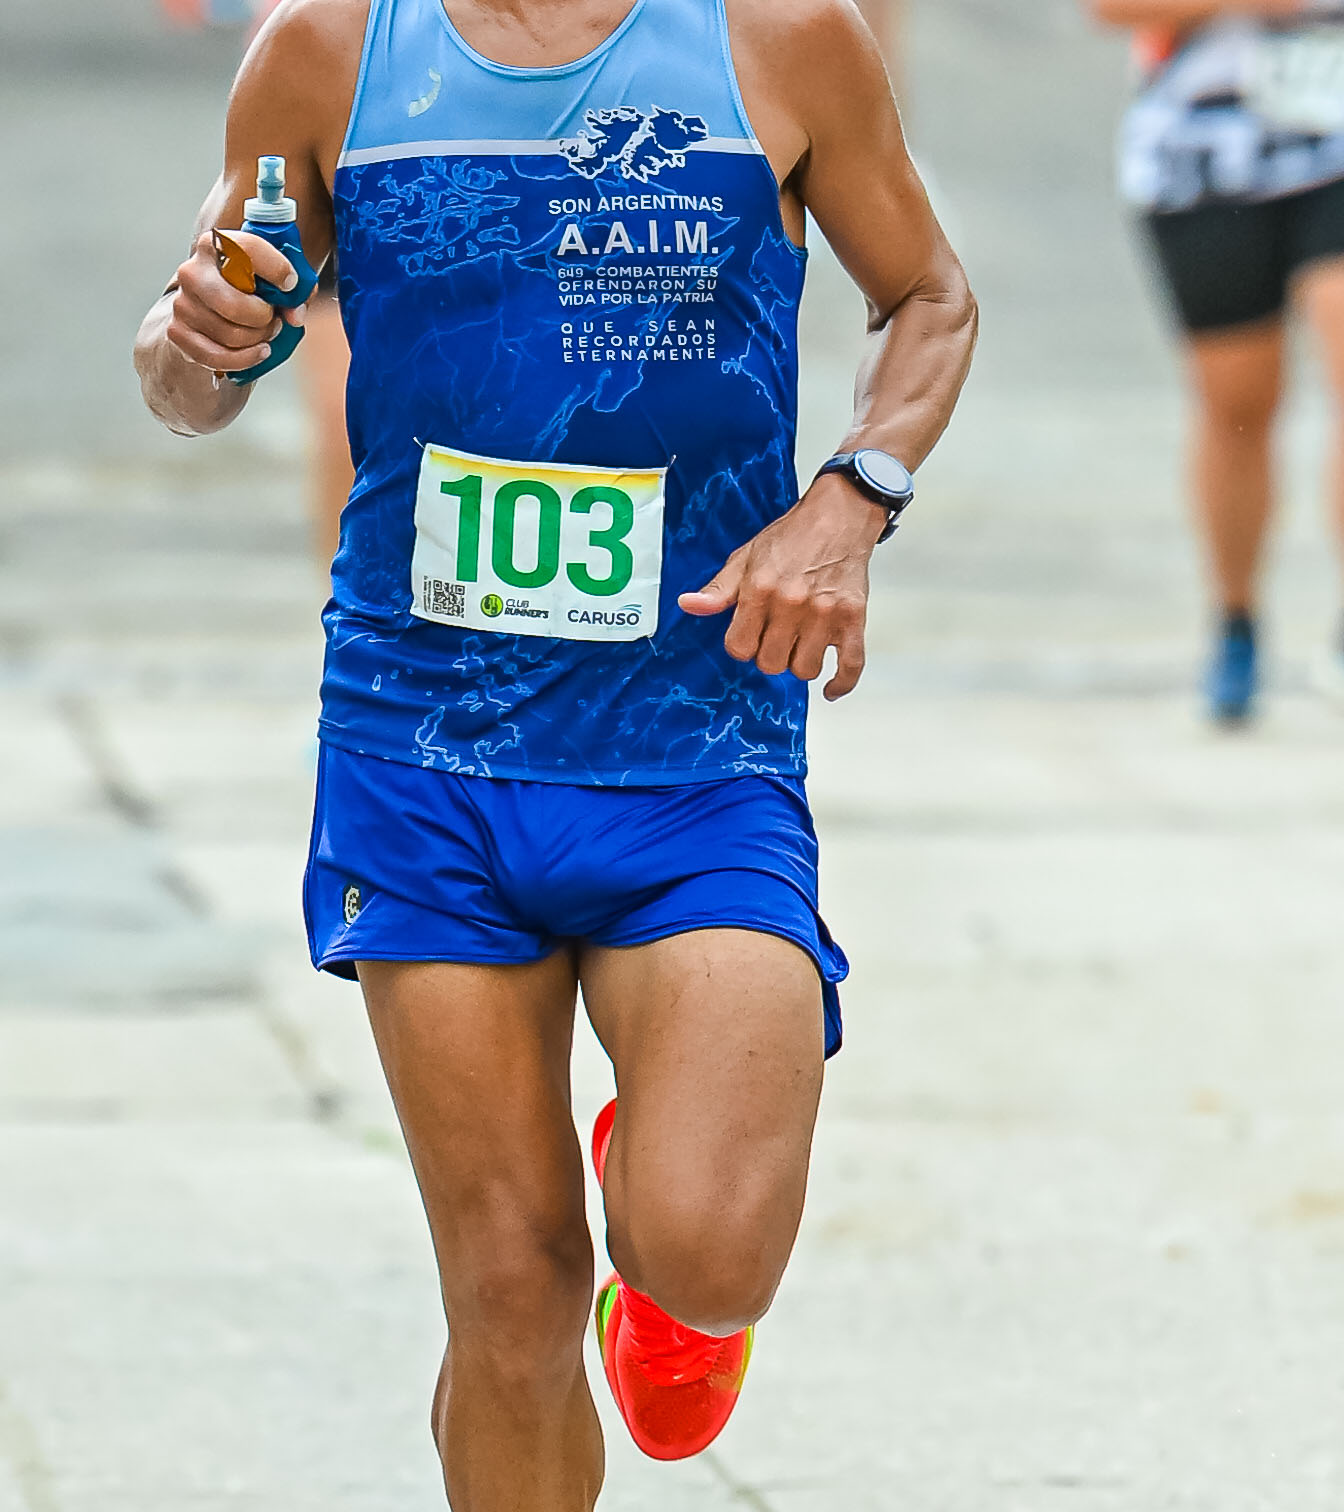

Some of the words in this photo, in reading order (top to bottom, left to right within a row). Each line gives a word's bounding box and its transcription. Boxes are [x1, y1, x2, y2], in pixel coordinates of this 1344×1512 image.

[548, 197, 591, 215] SON
[597, 194, 724, 212] ARGENTINAS
[557, 219, 719, 256] A.A.I.M.
[557, 267, 584, 279] 649
[595, 265, 719, 278] COMBATIENTES
[558, 278, 685, 292] OFRENDARON
[696, 279, 717, 290] SU
[558, 293, 596, 307] VIDA
[601, 293, 632, 305] POR
[637, 293, 658, 304] LA
[662, 292, 714, 303] PATRIA
[560, 321, 614, 334] QUE
[648, 319, 715, 332] SEAN
[562, 333, 716, 349] RECORDADOS
[563, 347, 716, 363] ETERNAMENTE
[439, 474, 634, 597] 103
[567, 609, 640, 626] CARUSO
